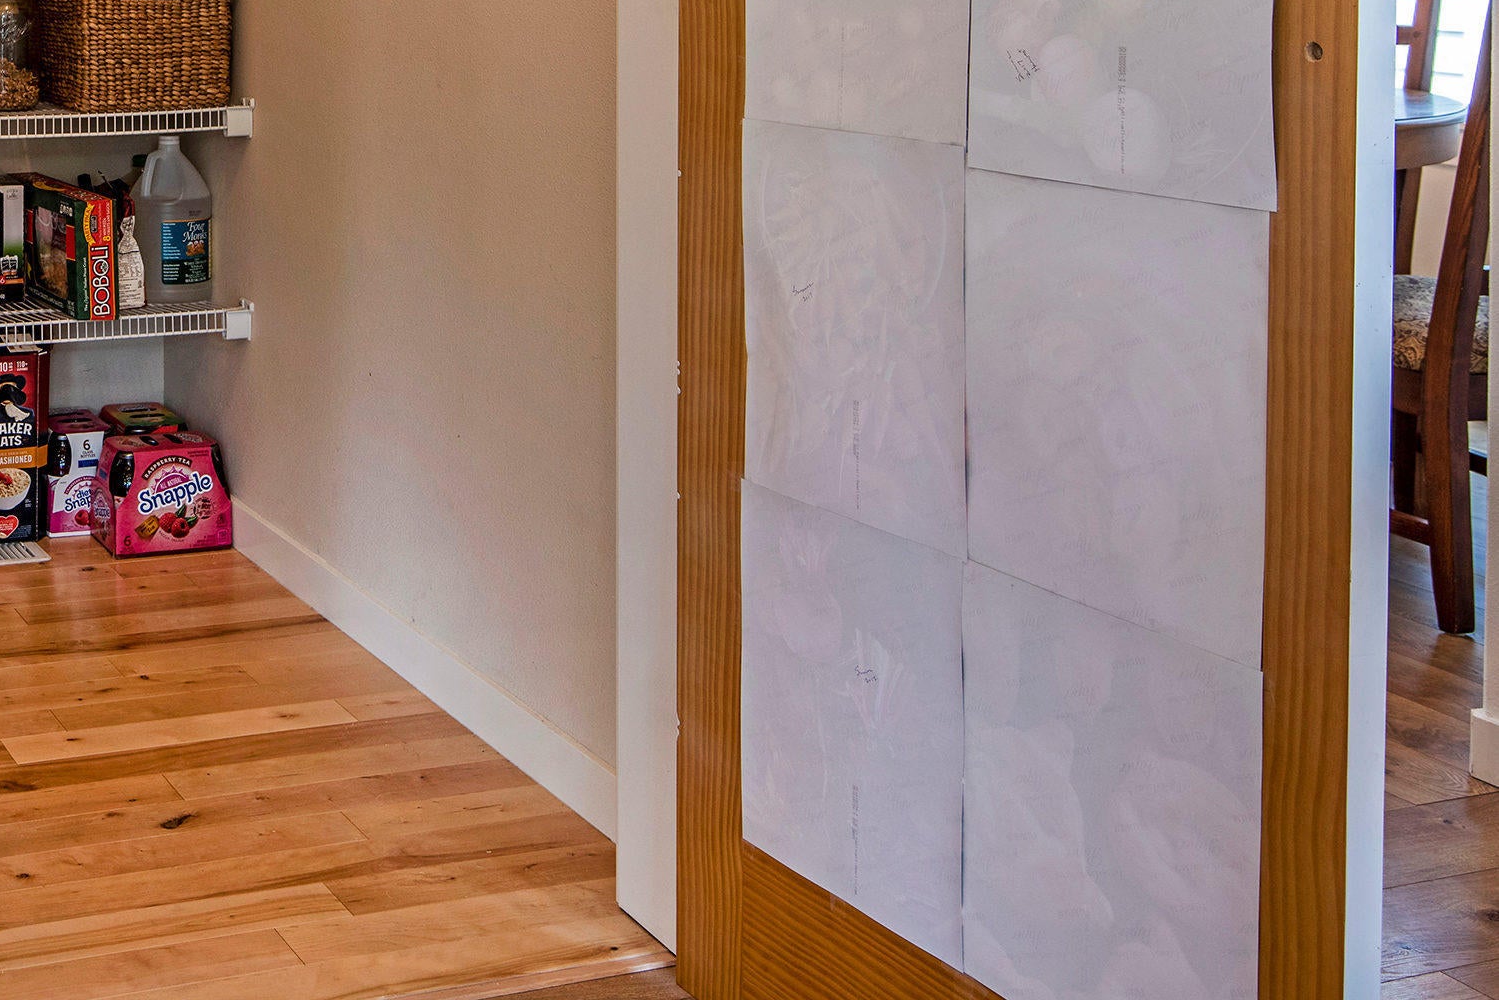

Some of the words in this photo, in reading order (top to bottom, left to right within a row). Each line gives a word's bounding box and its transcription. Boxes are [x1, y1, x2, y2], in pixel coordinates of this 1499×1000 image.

[186, 221, 205, 232] Four
[182, 231, 207, 243] Monks
[0, 361, 8, 372] 10
[83, 439, 91, 451] 6
[143, 456, 176, 479] RASPBERRY
[177, 457, 191, 466] TEA
[139, 473, 212, 513] Snapple
[64, 497, 92, 512] Snap
[123, 535, 132, 546] 6
